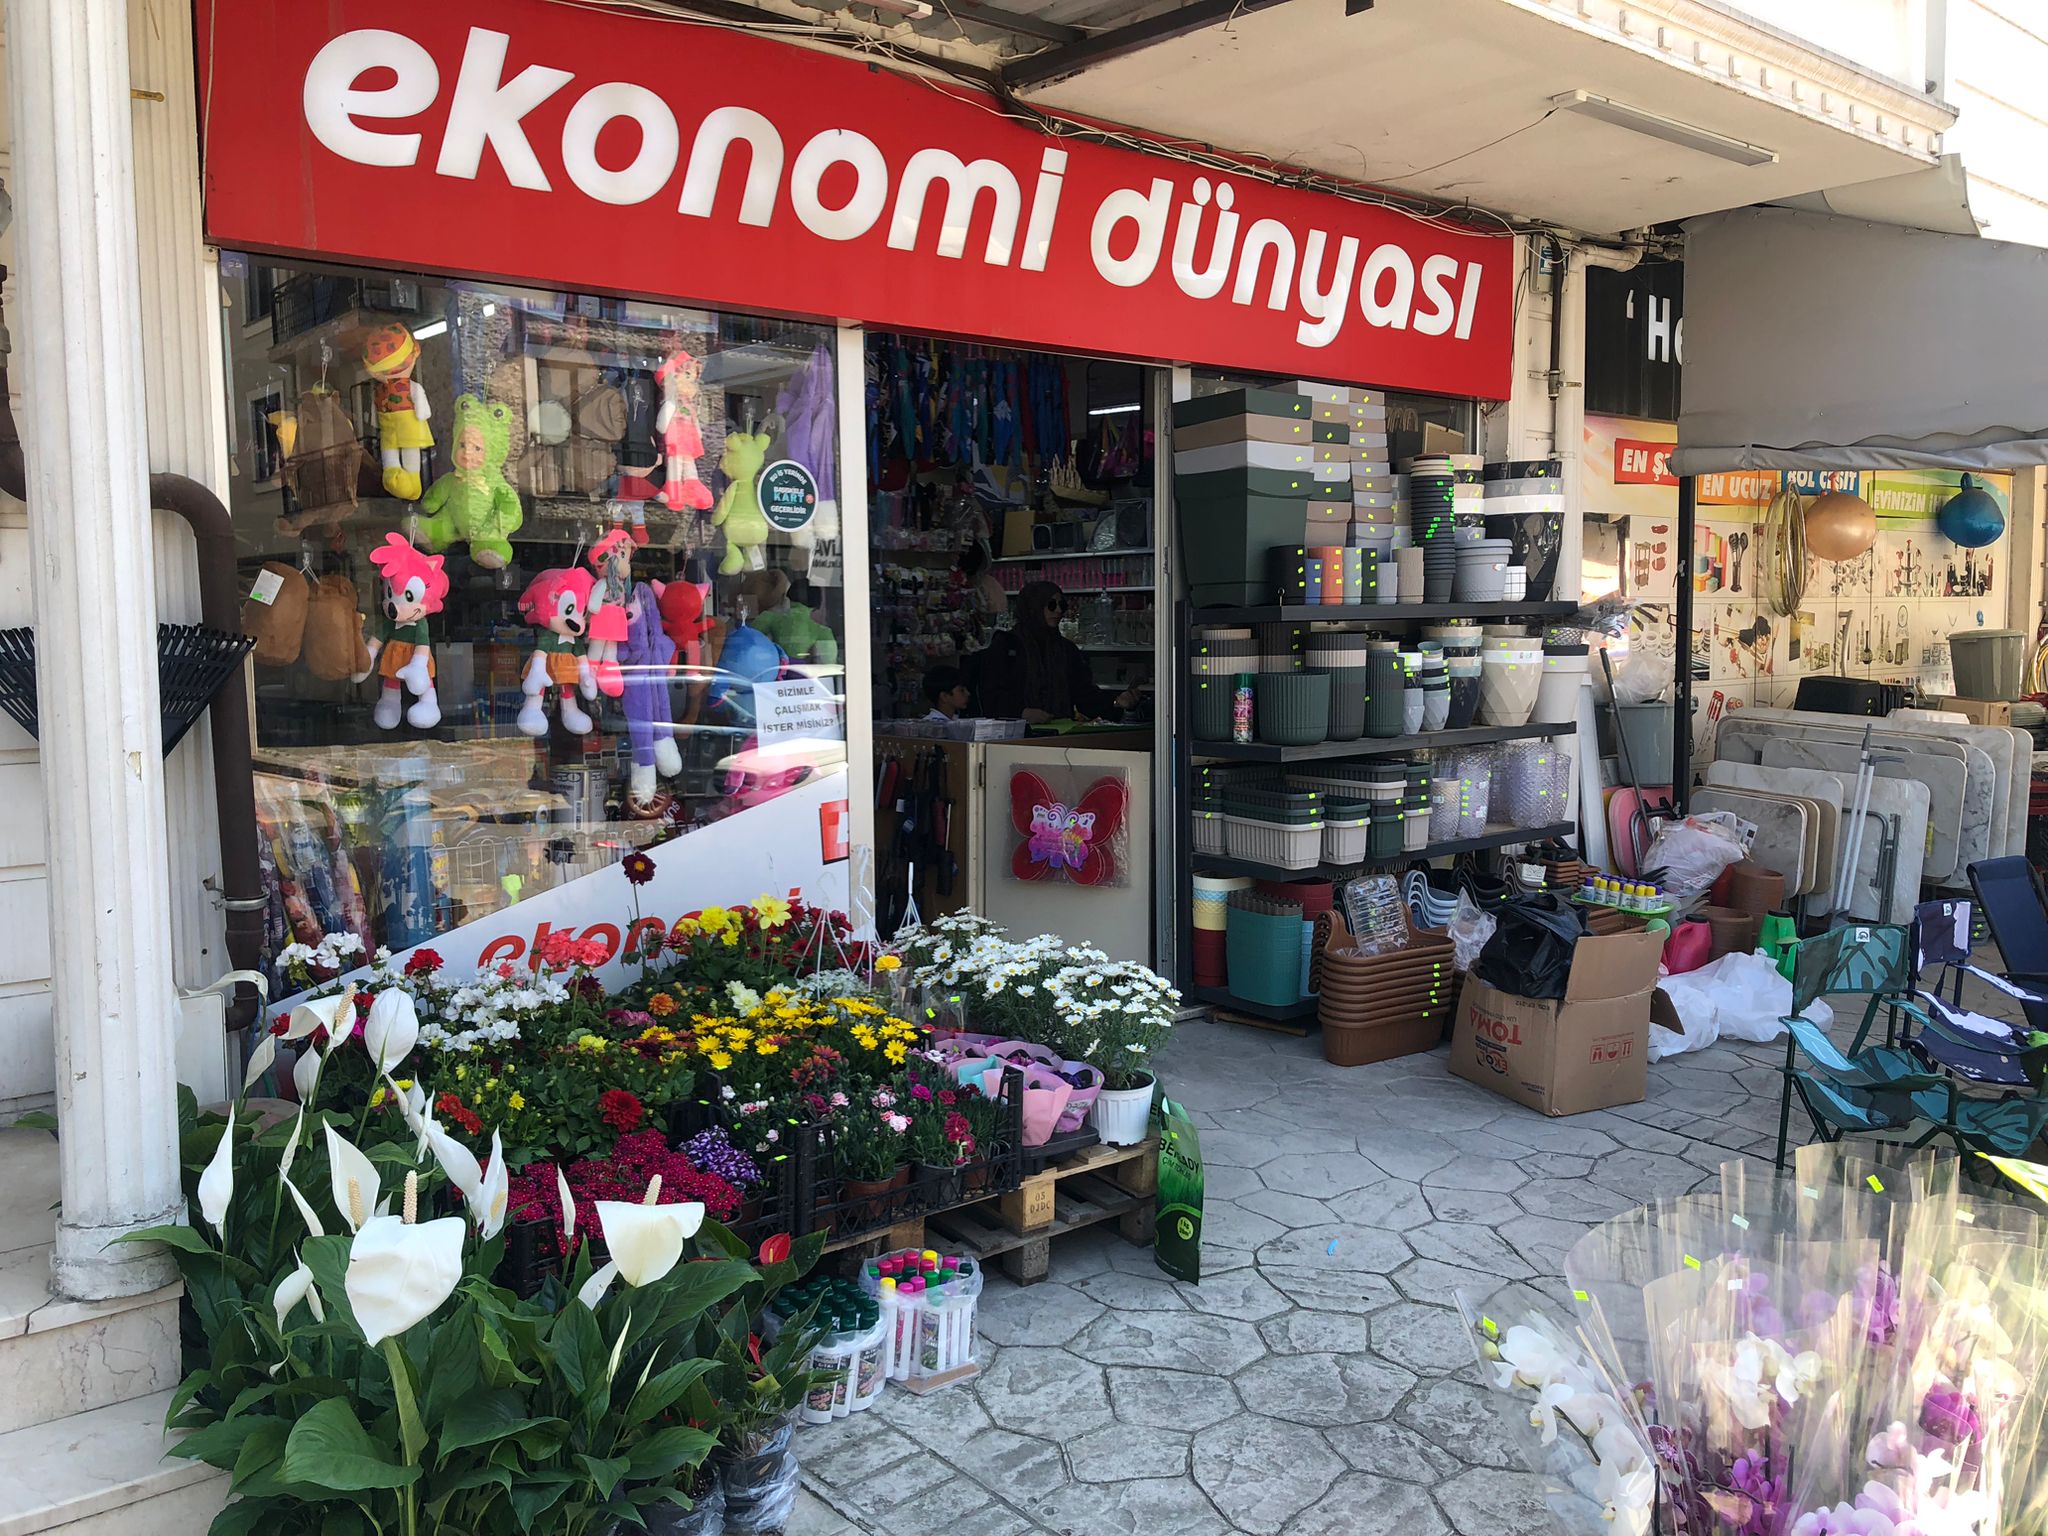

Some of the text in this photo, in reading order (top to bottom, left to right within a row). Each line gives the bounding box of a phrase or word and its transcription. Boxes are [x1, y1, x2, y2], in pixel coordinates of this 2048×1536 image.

[303, 26, 1483, 348] ekonomi dünyası
[1621, 448, 1647, 473] EN
[773, 492, 805, 503] KART
[1702, 474, 1772, 499] EN UCUZ
[1874, 489, 1926, 513] EVİNİZİN
[777, 686, 816, 698] BİZİMLE
[774, 703, 822, 717] ÇALIŞMAK
[763, 718, 834, 733] İSTER MİSİNİZ?
[1471, 1006, 1523, 1046] TOMA
